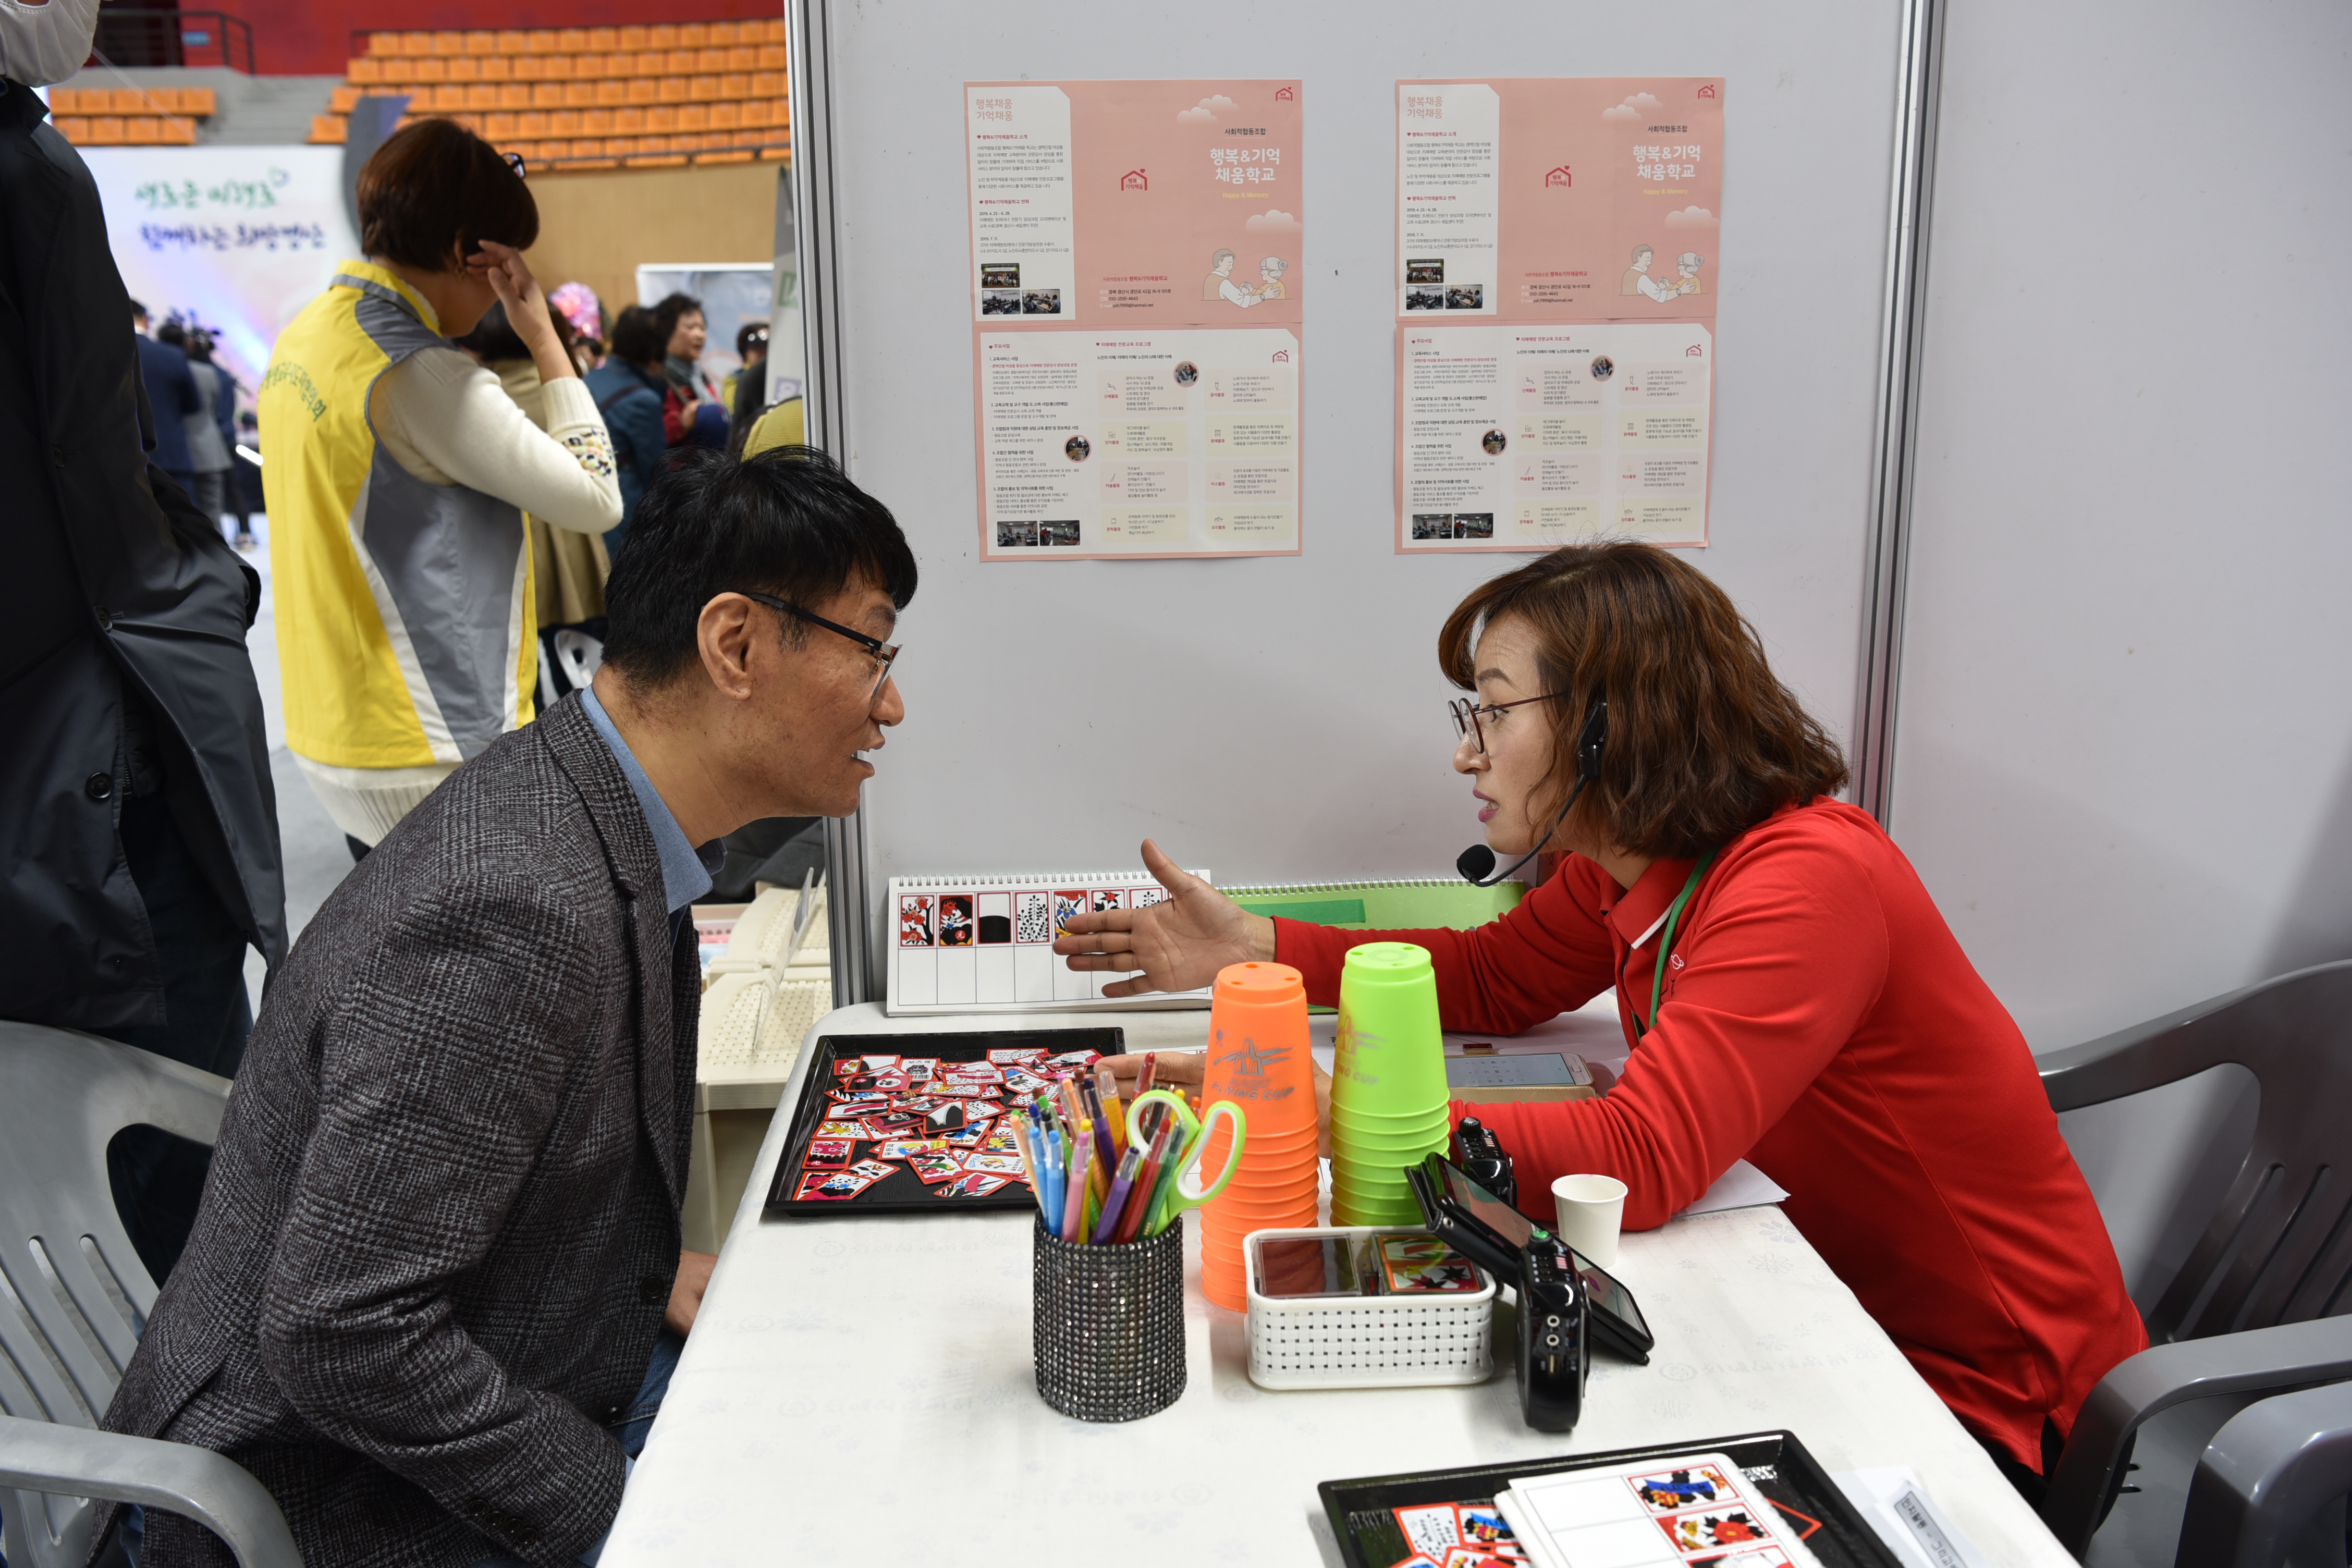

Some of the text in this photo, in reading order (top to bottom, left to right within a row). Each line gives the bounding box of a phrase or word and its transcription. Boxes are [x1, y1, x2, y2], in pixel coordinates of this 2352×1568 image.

[976, 99, 1013, 109] 행복채움
[1407, 96, 1443, 107] 행복채움
[976, 111, 1013, 121] 기억채움
[1407, 108, 1443, 119] 기억채움
[1210, 148, 1280, 166] 행복&기억
[1633, 145, 1700, 163] 행복&기억
[1215, 167, 1276, 185] 채움학교
[1637, 164, 1695, 181] 채움학교
[1228, 1076, 1271, 1089] MAGIC
[1353, 1072, 1379, 1085] CUP
[1212, 1082, 1295, 1100] FLYING CUP
[1901, 1498, 1928, 1529] 인지활동
